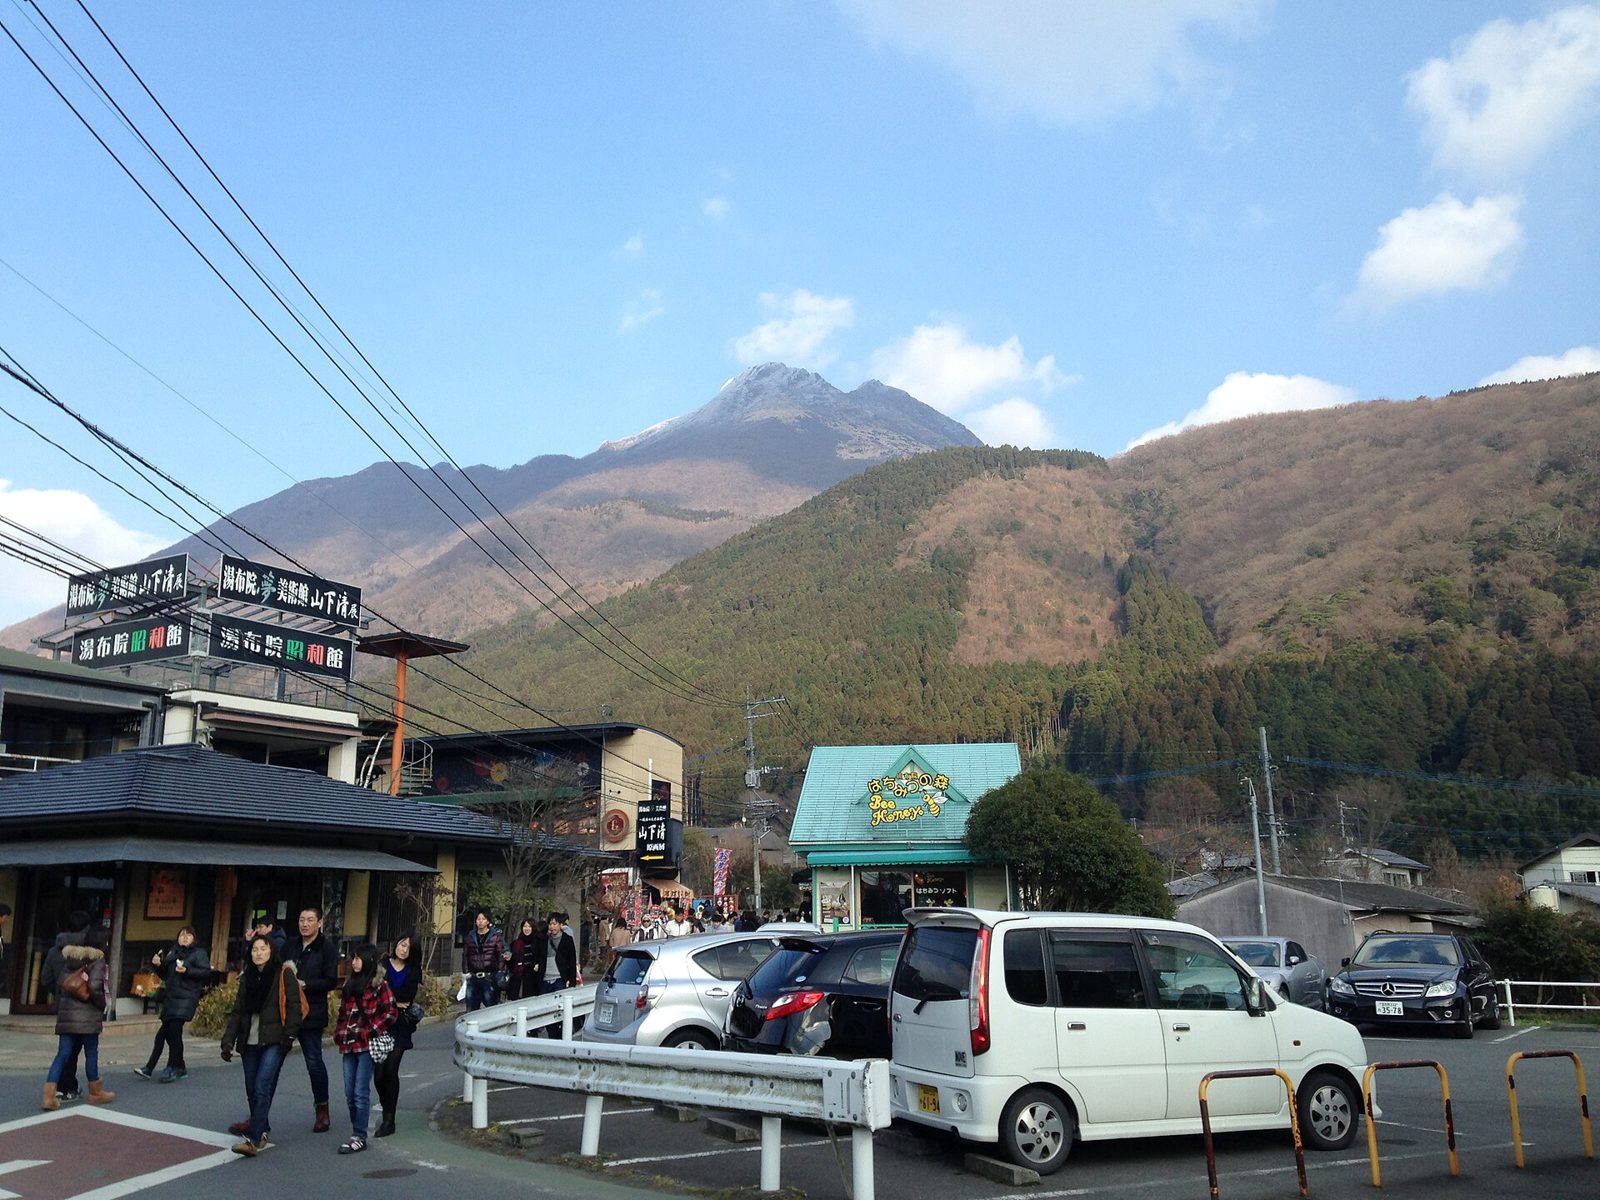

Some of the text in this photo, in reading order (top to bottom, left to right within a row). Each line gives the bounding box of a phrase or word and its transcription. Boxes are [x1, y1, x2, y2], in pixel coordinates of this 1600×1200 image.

[79, 623, 182, 660] 湯布院昭和館
[220, 626, 344, 669] 湯布院昭和館
[868, 773, 949, 798] はちみつの森
[869, 794, 896, 810] Bee
[638, 822, 666, 841] 山下清
[1382, 1006, 1402, 1014] 35-78
